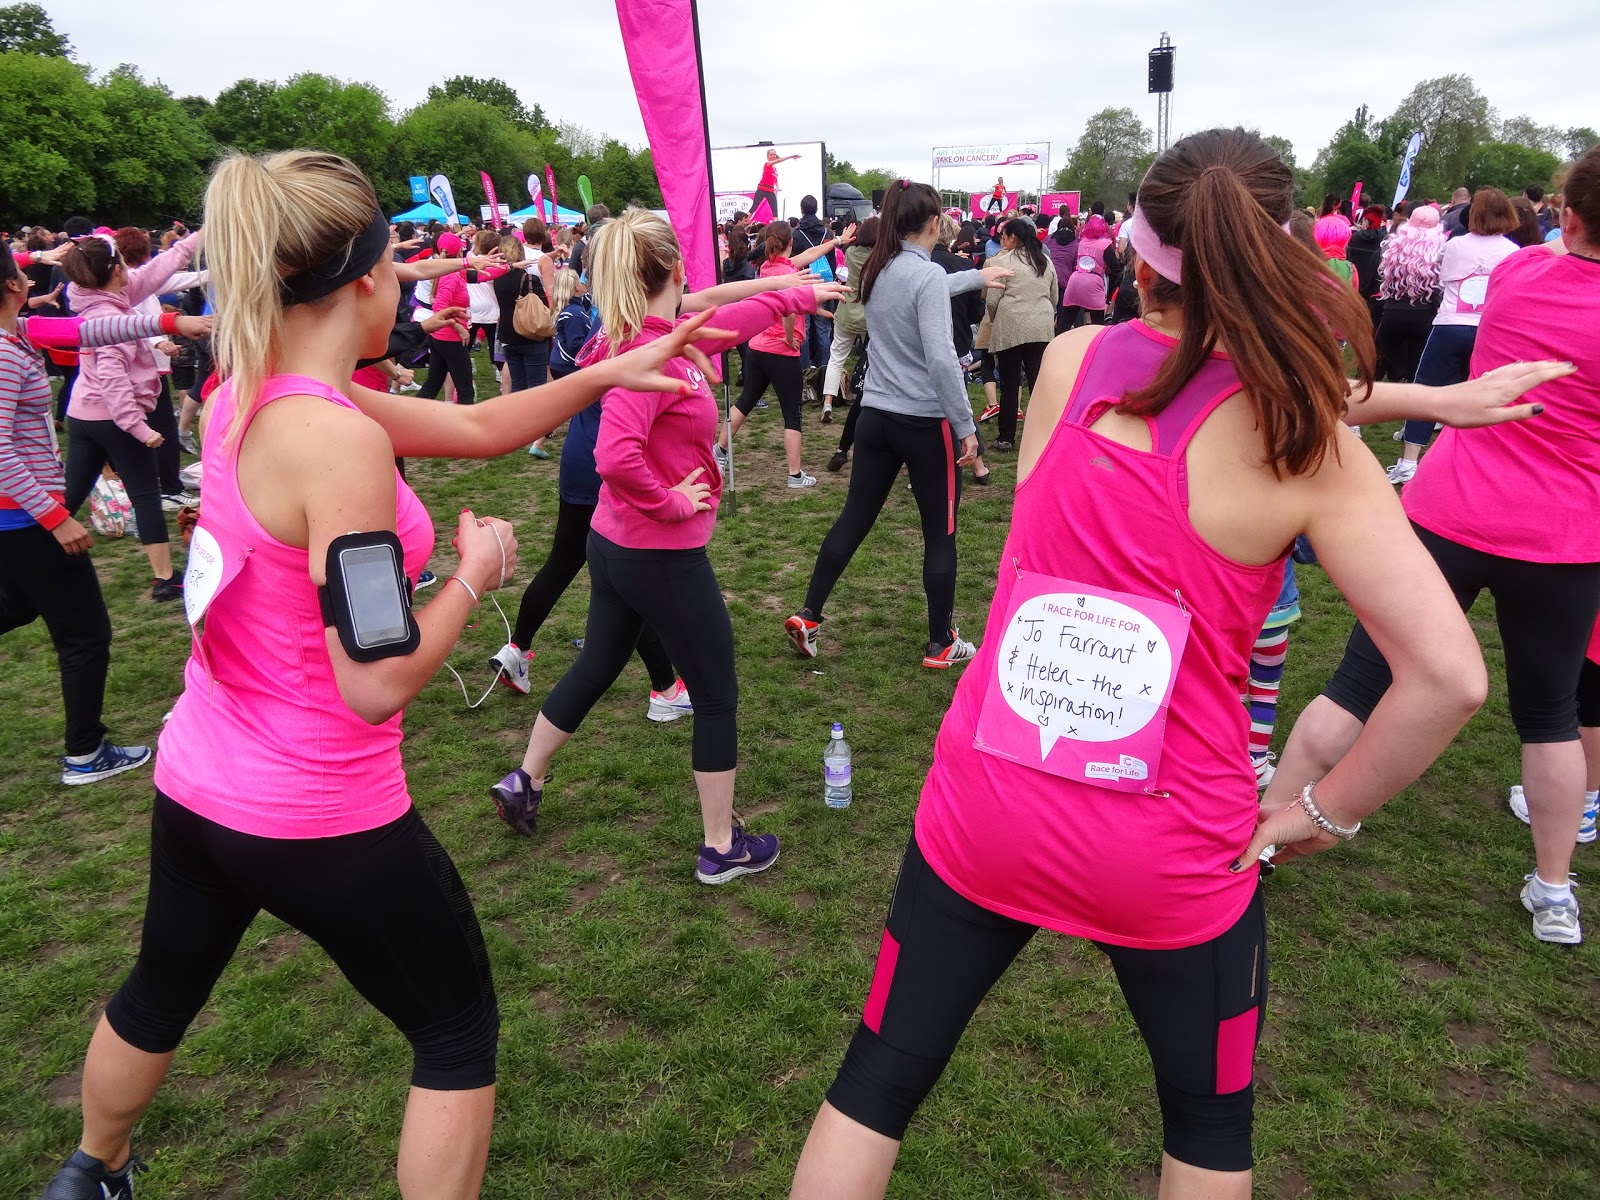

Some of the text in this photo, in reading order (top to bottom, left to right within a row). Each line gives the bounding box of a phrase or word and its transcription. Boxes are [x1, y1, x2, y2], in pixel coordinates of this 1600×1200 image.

[936, 154, 999, 164] TAKE ON CANCER?
[1042, 602, 1141, 634] I RACE FOR LIFE FOR
[1022, 619, 1045, 642] Jo
[1059, 625, 1137, 665] Farrant
[1027, 653, 1073, 686] Helen
[1092, 674, 1123, 700] the
[1019, 682, 1124, 728] inspiration!
[1090, 764, 1140, 777] Race for Life
